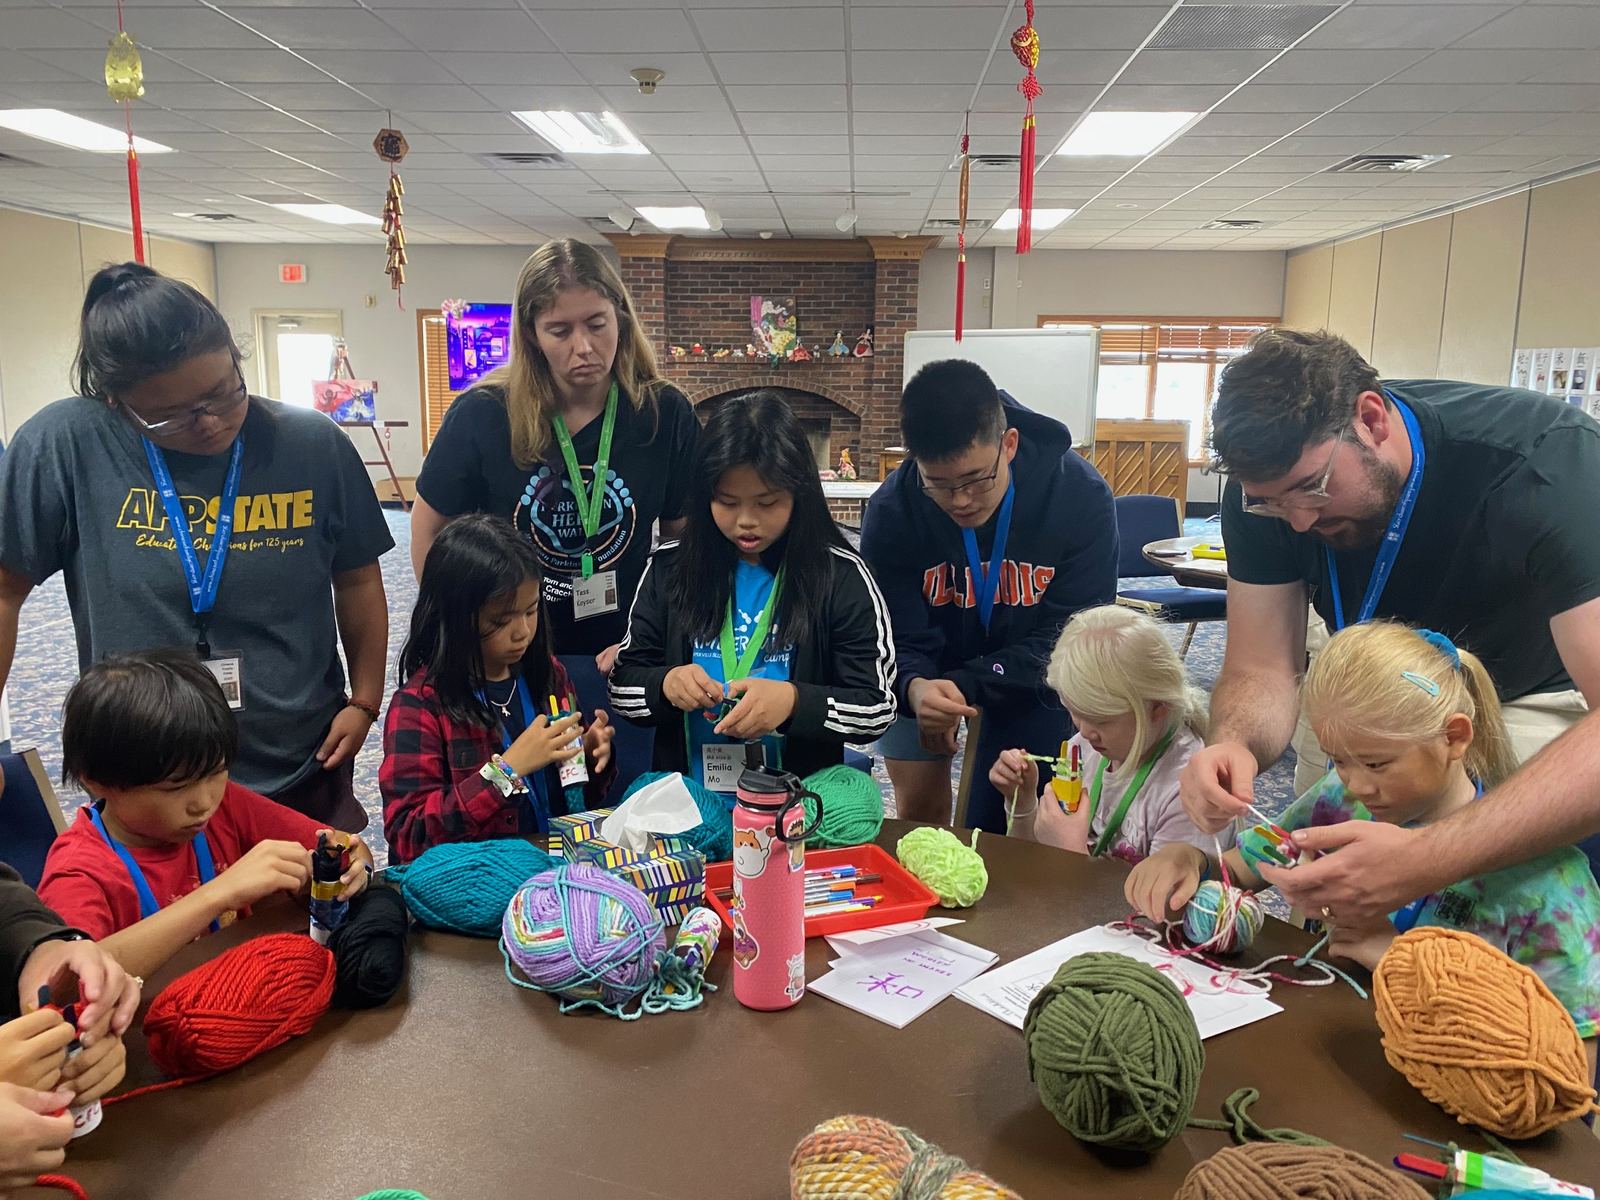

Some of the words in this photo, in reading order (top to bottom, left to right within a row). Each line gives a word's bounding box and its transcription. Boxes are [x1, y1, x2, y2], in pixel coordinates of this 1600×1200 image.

[136, 533, 178, 551] Educat
[249, 539, 263, 551] for
[266, 537, 280, 547] 125
[282, 537, 304, 553] years
[597, 530, 627, 562] oundation
[922, 559, 1055, 609] ILLIOIS
[707, 763, 732, 771] Emilia
